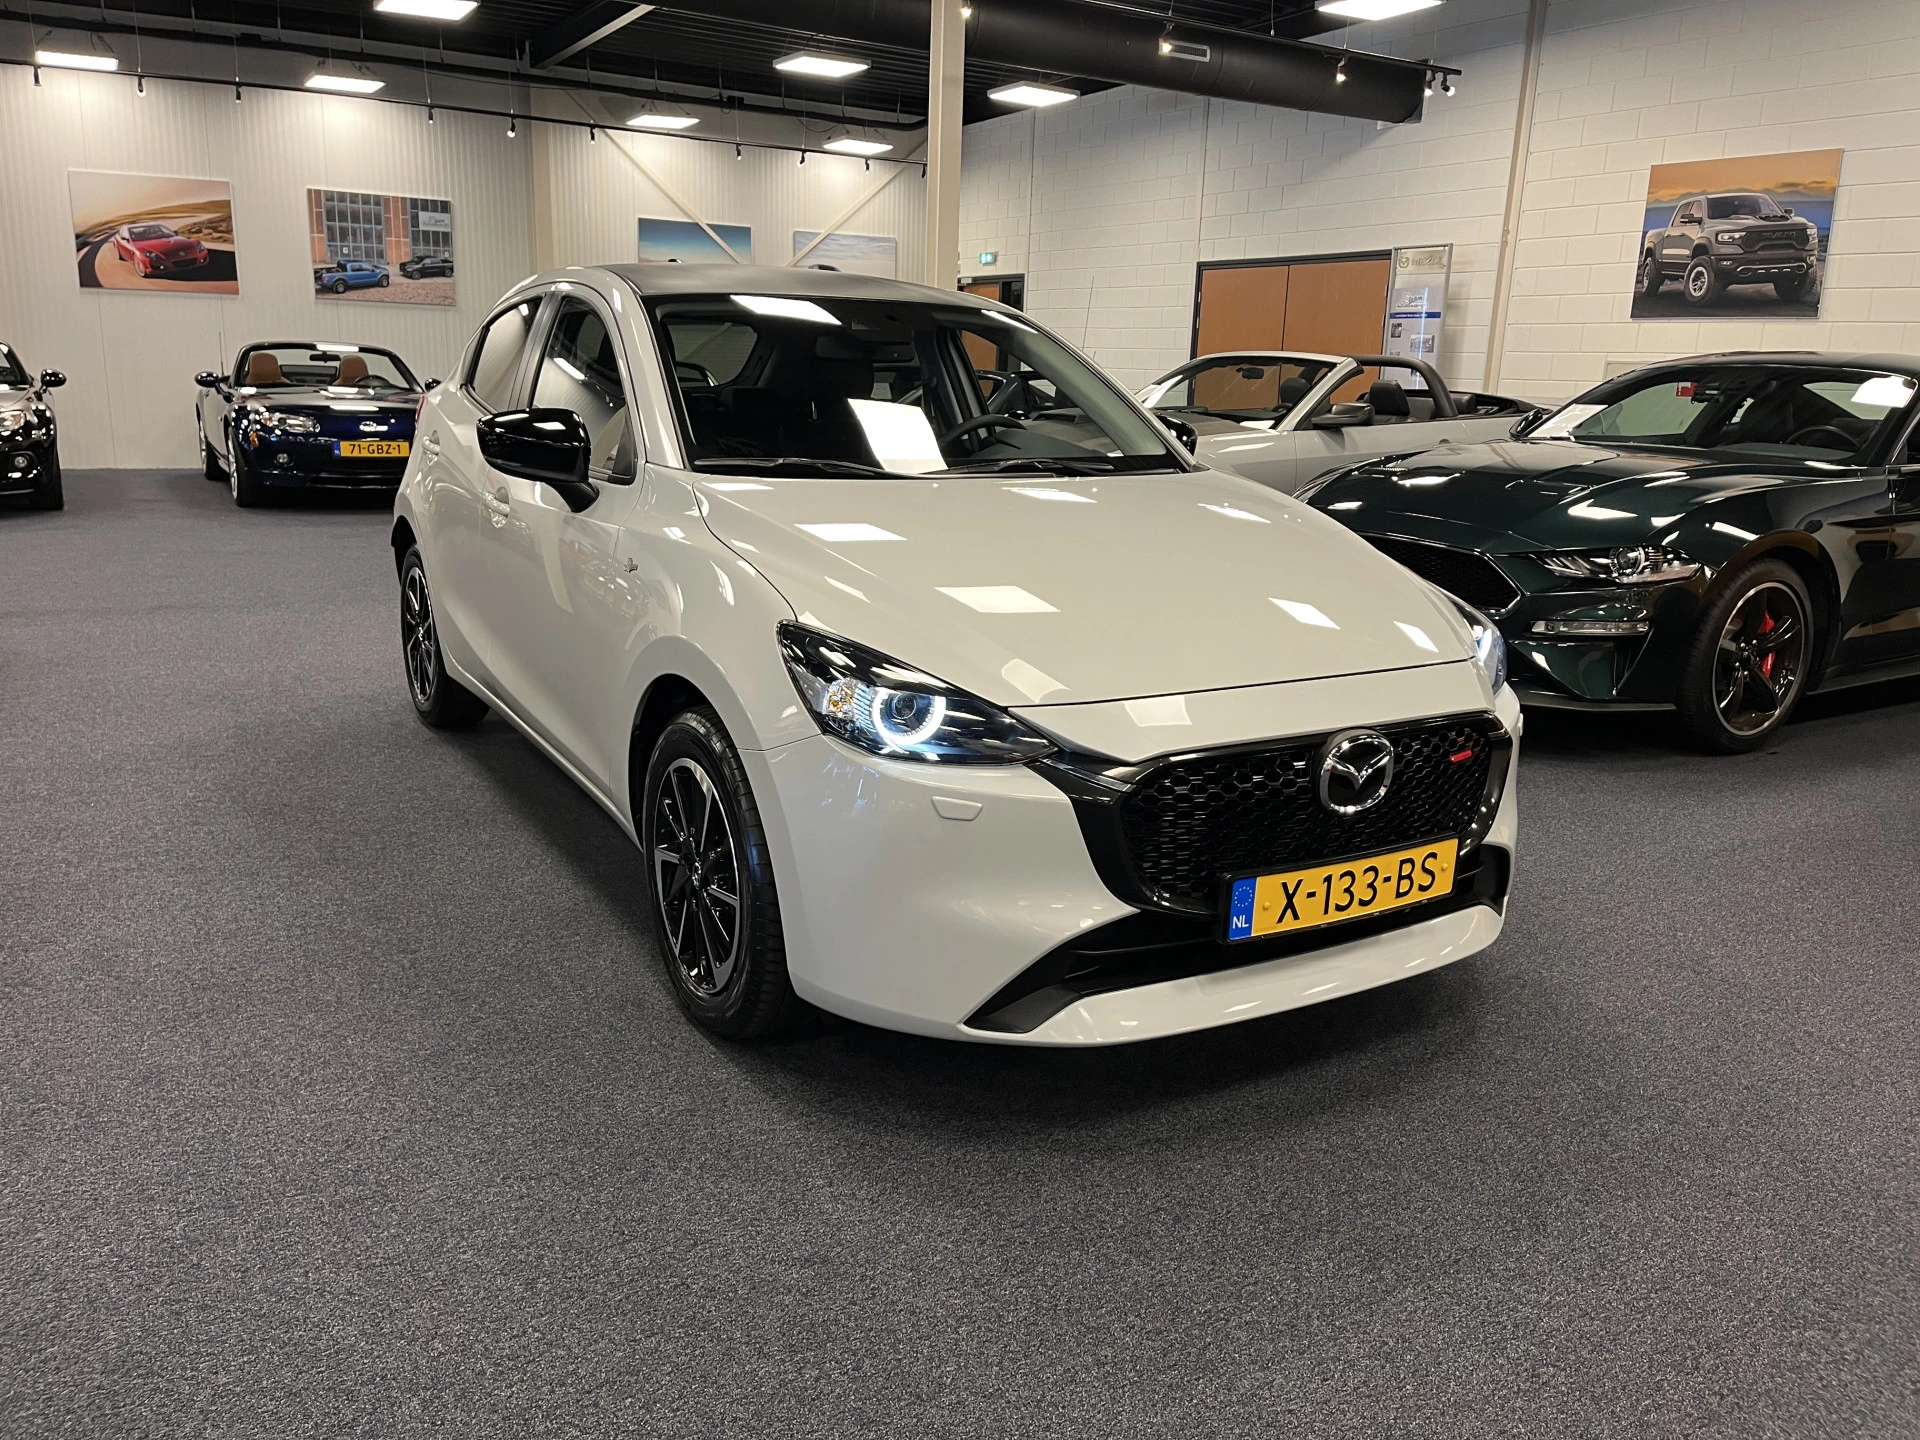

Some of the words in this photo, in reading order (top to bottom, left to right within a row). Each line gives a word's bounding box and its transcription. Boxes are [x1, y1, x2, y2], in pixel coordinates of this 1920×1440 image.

[349, 444, 401, 455] 71-GBZ-1
[1276, 851, 1438, 924] X-133-BS
[1232, 914, 1249, 929] NL
